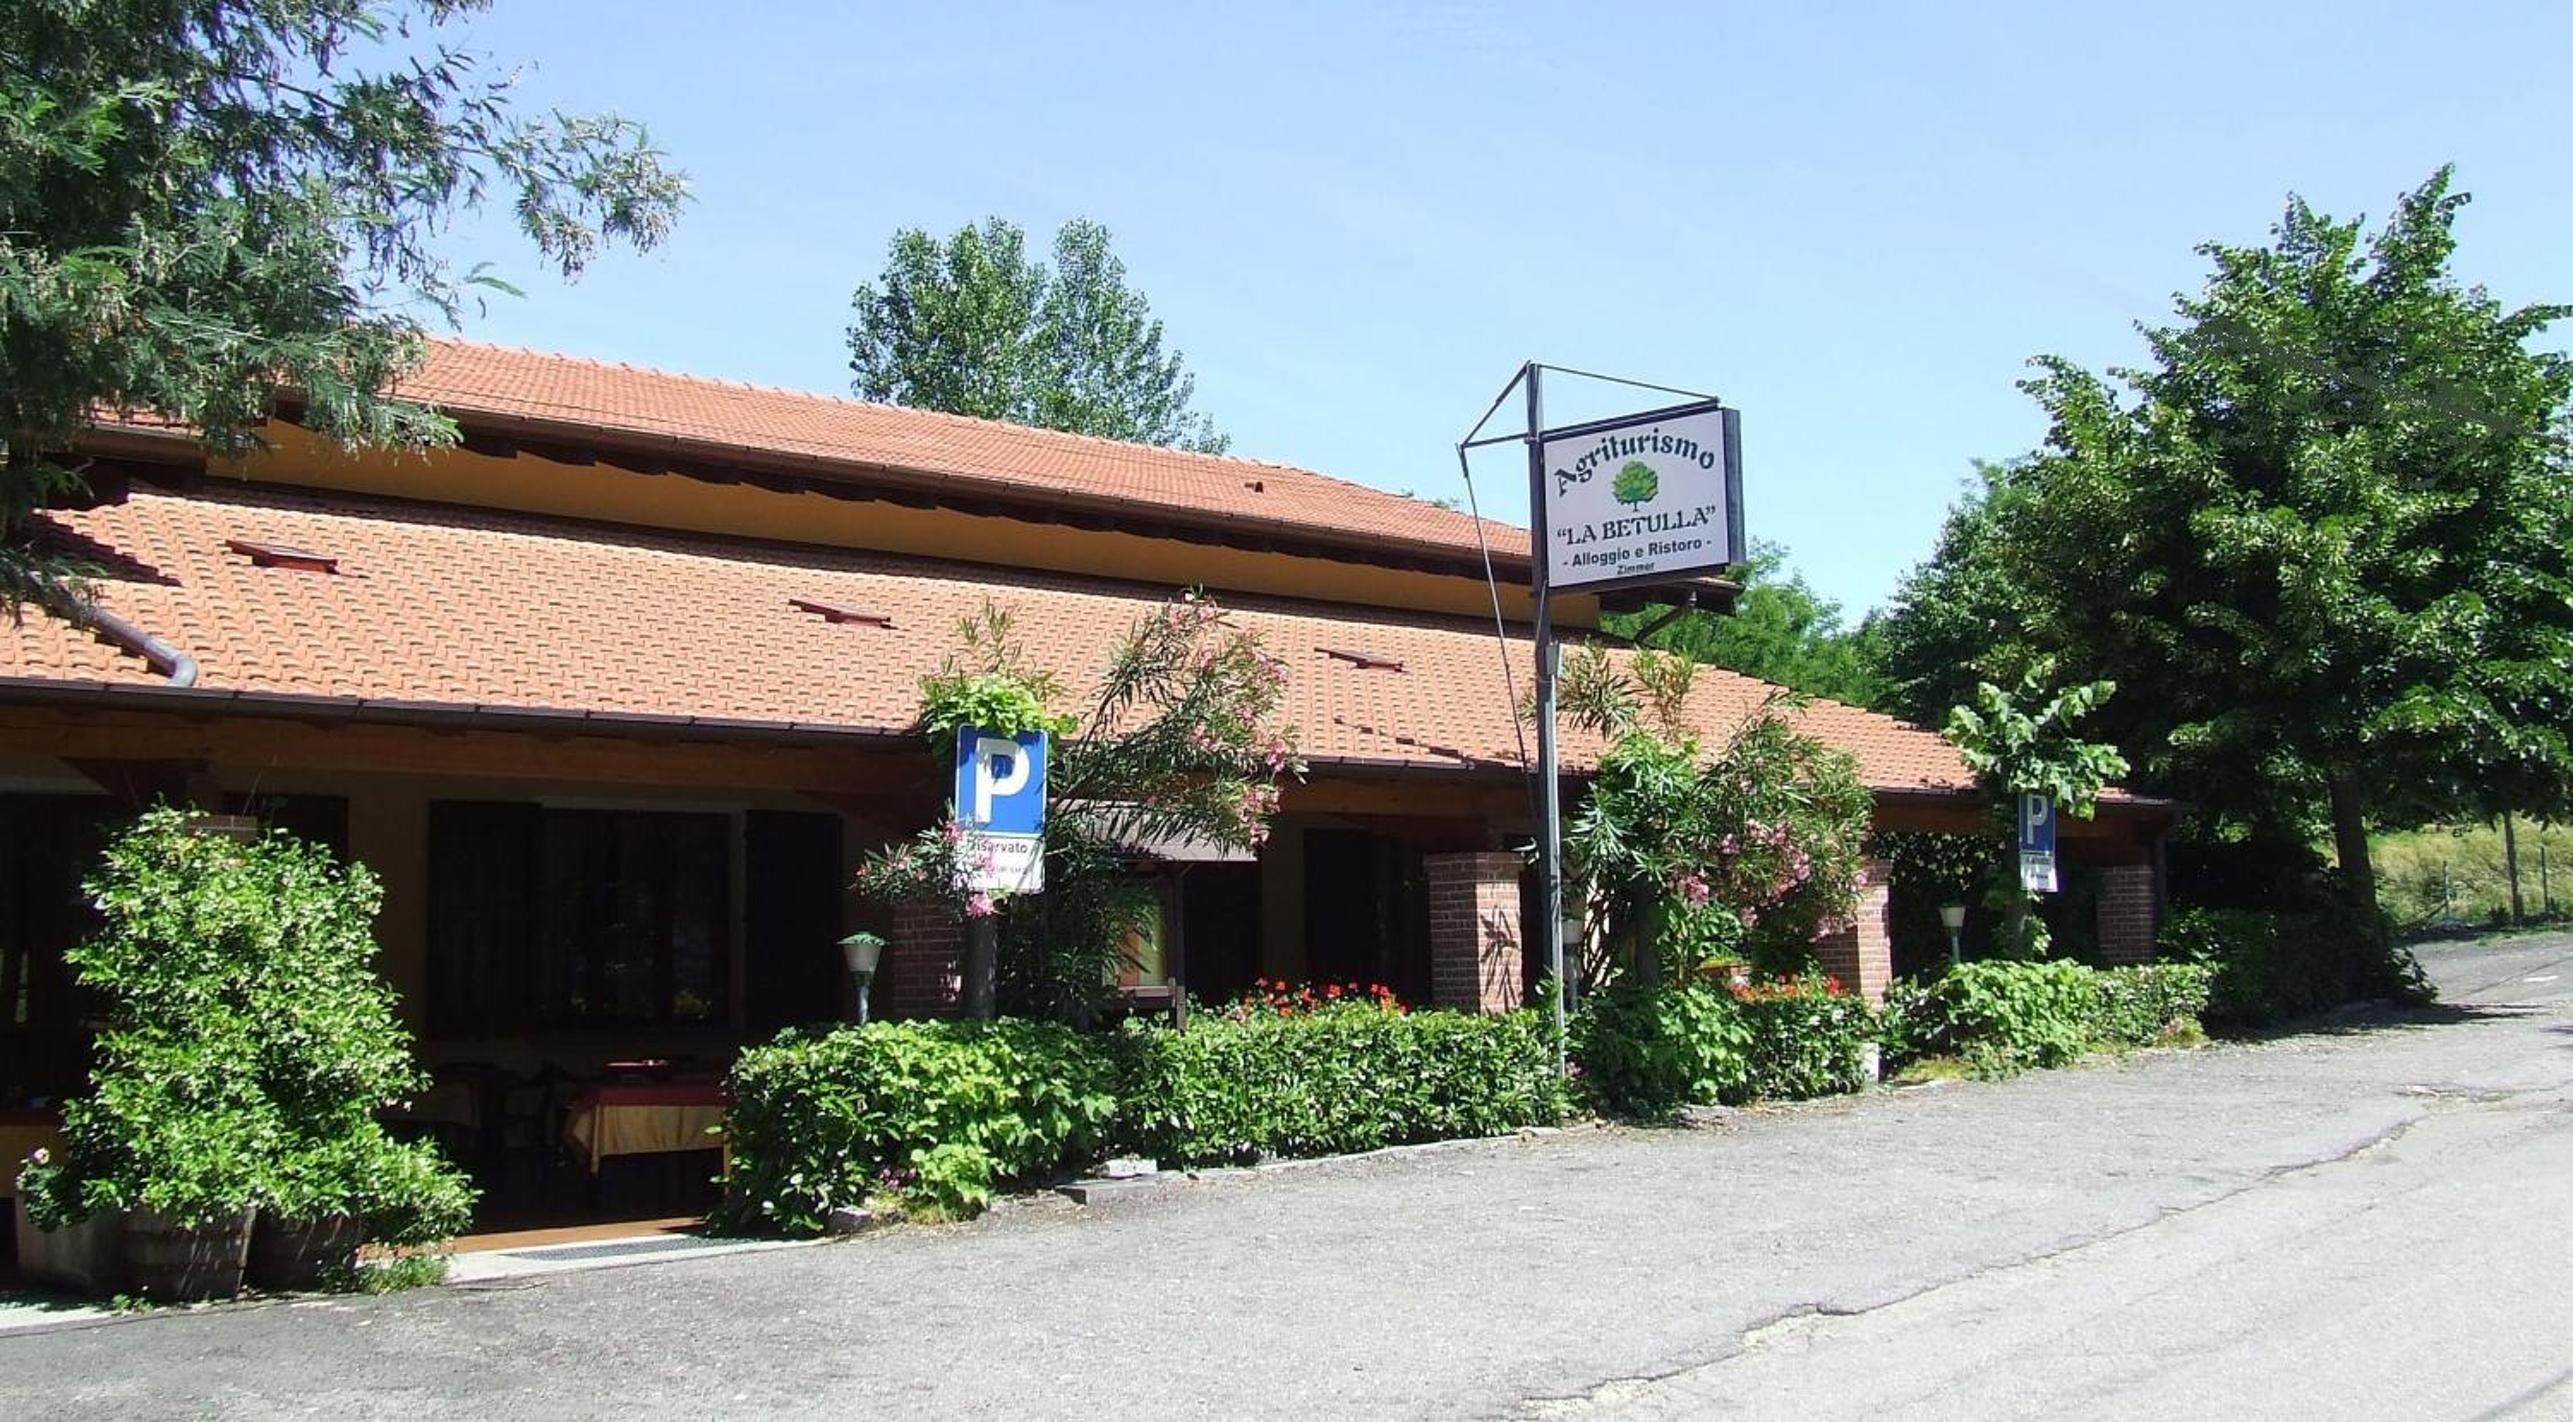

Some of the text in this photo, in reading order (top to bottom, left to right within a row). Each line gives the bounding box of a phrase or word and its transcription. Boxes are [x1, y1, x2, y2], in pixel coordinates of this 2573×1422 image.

[1554, 427, 1715, 497] Agriturismo
[1572, 547, 1630, 567] Alloggio
[1635, 547, 1644, 558] e
[1648, 538, 1702, 556] Ristoro
[1617, 562, 1655, 575] Zimmer
[975, 737, 1030, 823] P
[2026, 794, 2049, 844] P
